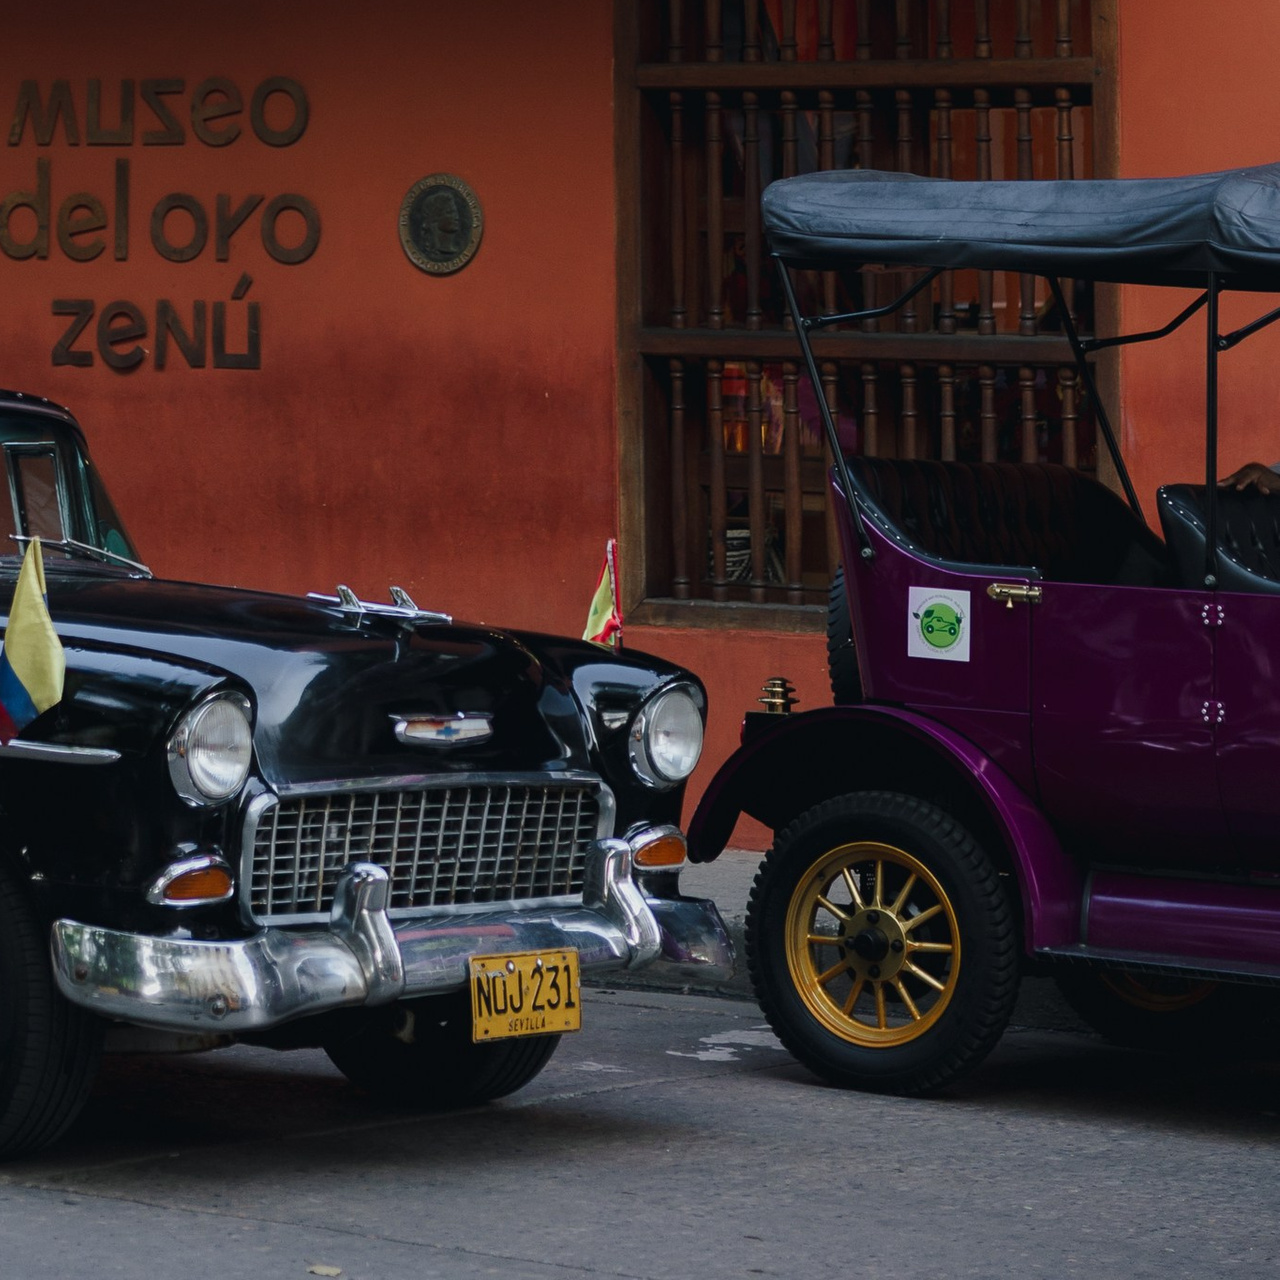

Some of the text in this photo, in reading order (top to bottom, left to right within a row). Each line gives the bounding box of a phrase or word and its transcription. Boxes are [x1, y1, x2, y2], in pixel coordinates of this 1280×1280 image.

[150, 193, 322, 265] oro
[531, 964, 576, 1012] 231
[508, 1016, 546, 1032] SEVILLA
